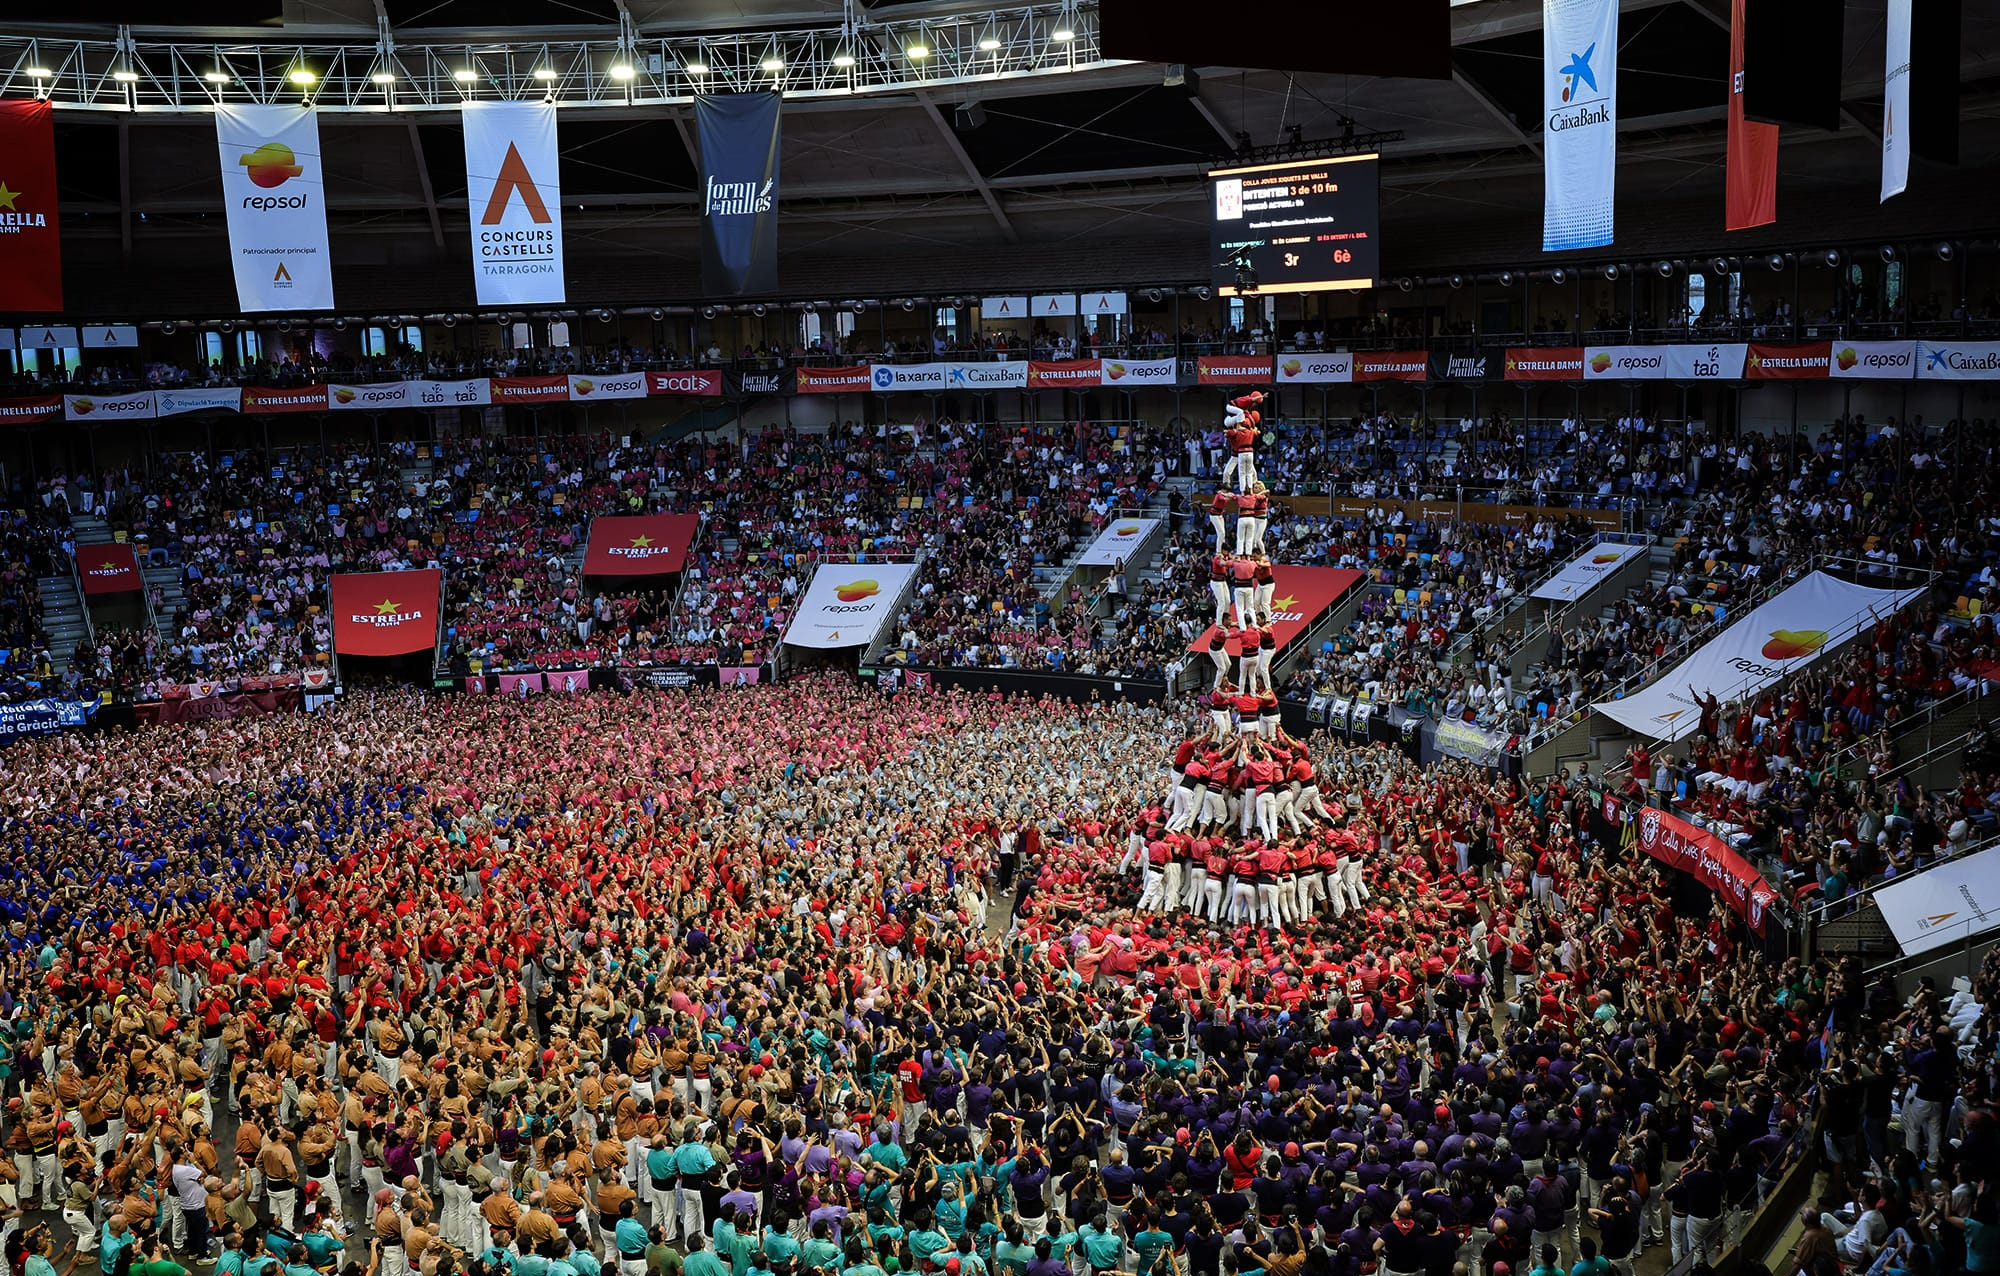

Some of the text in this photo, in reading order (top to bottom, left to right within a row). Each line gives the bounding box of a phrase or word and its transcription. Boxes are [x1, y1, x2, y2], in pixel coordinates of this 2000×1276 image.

[1549, 104, 1610, 132] CaixaBank
[1310, 172, 1329, 180] VALLS
[1290, 186, 1297, 196] 3
[1298, 186, 1310, 195] de
[1312, 184, 1324, 193] 10
[1325, 183, 1338, 192] fm
[243, 193, 307, 212] repsol
[711, 182, 772, 215] de nulles
[481, 230, 553, 243] CONCURS
[287, 247, 317, 255] principal
[481, 243, 554, 256] CASTELLS
[1333, 249, 1352, 263] 6è
[1284, 252, 1300, 267] 3r
[483, 264, 555, 275] TARRAGONA
[1517, 360, 1582, 371] ESTRELLA DAMM
[1617, 355, 1663, 370] repsol
[1761, 357, 1829, 369] ESTRELLA DAMM
[1864, 351, 1911, 369] repsol
[1132, 365, 1172, 378] repsol
[1210, 367, 1271, 376] ESTRELLA DAMM
[1307, 361, 1349, 375] repsol
[1364, 363, 1426, 372] ESTRELLA DAMM
[1693, 358, 1720, 377] tac
[809, 375, 871, 385] ESTRELLA DAMM
[895, 371, 942, 383] la xarxa
[968, 368, 1025, 382] CaixaBank
[1040, 370, 1101, 379] ESTRELLA DAMM
[600, 379, 642, 392] repsol
[656, 375, 698, 391] 3cat
[362, 389, 406, 402] repsol
[454, 391, 478, 402] tac
[503, 385, 568, 395] ESTRELLA DAMM
[257, 394, 326, 405] ESTRELLA DAMM
[421, 391, 444, 403] tac
[33, 403, 61, 414] DAMM
[102, 399, 150, 412] repsol
[608, 546, 669, 555] ESTRELLA
[822, 603, 876, 614] repsol
[352, 611, 422, 623] ESTRELLA
[1726, 656, 1791, 679] repsol
[1, 713, 26, 722] de la
[1661, 829, 1679, 852] Colla
